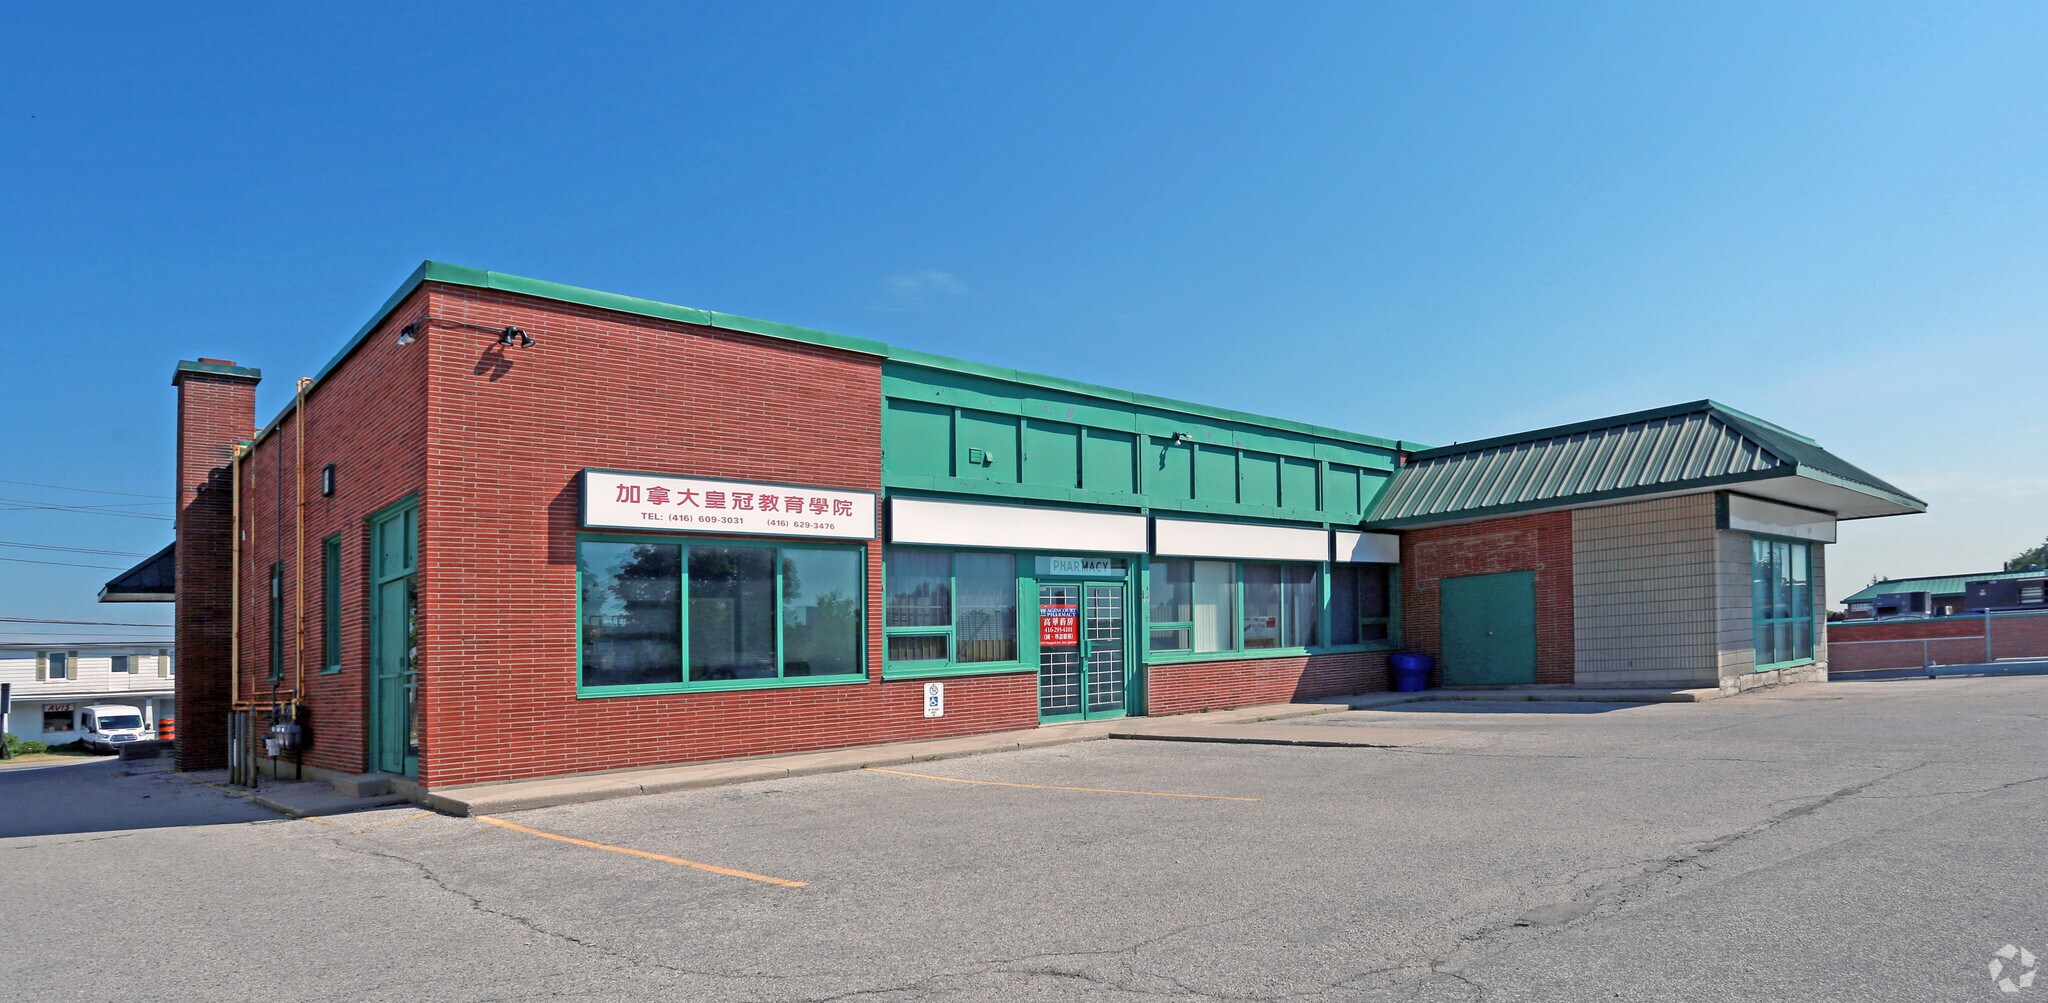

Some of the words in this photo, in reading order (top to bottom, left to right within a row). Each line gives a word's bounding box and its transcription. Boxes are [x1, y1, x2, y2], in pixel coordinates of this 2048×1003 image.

[615, 483, 853, 517] 加拿大皇冠教育學院
[641, 512, 664, 521] TEL:
[668, 514, 693, 523] (416)
[698, 515, 744, 525] 609-3031
[767, 519, 789, 528] (416)
[793, 521, 835, 530] 629-3476
[1053, 560, 1109, 573] PHARMACY
